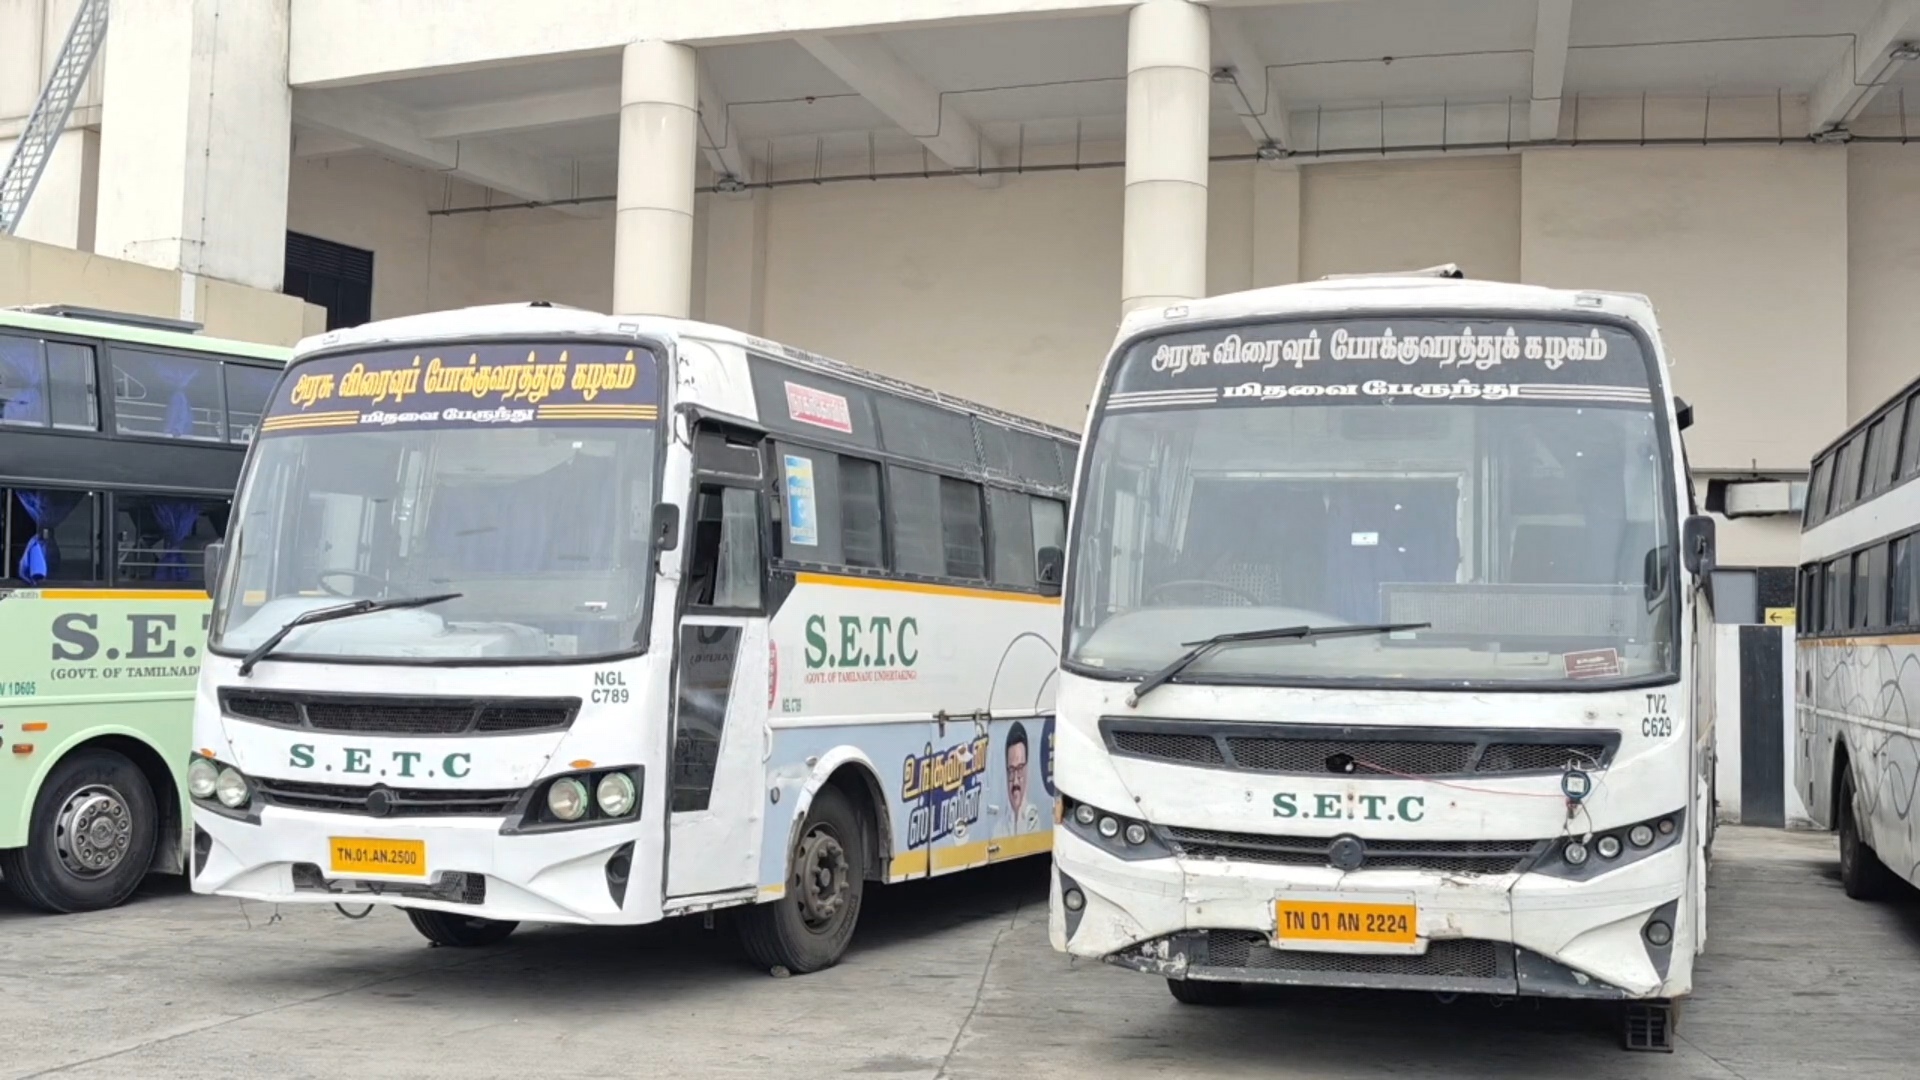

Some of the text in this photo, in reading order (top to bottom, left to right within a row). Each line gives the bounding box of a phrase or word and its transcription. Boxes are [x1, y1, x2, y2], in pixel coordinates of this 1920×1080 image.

[1151, 326, 1608, 377] அரசு விரைவுப் போக்குவரத்துக் கழகம்
[291, 373, 335, 411] அரசு
[571, 349, 637, 401] கழகம்
[1222, 378, 1521, 401] மிதவை பேருந்து
[51, 612, 211, 661] S.E.
[804, 614, 919, 669] S.E.T.C
[50, 667, 98, 680] (GOVT.
[103, 667, 122, 678] OF
[594, 671, 626, 686] NGL
[591, 689, 629, 704] C789
[1646, 694, 1667, 714] TV2
[1641, 716, 1672, 737] C629
[289, 743, 472, 778] S.E.T.C
[1272, 792, 1425, 822] S.E.T.C
[1284, 911, 1408, 933] TN 01 AN 2224
